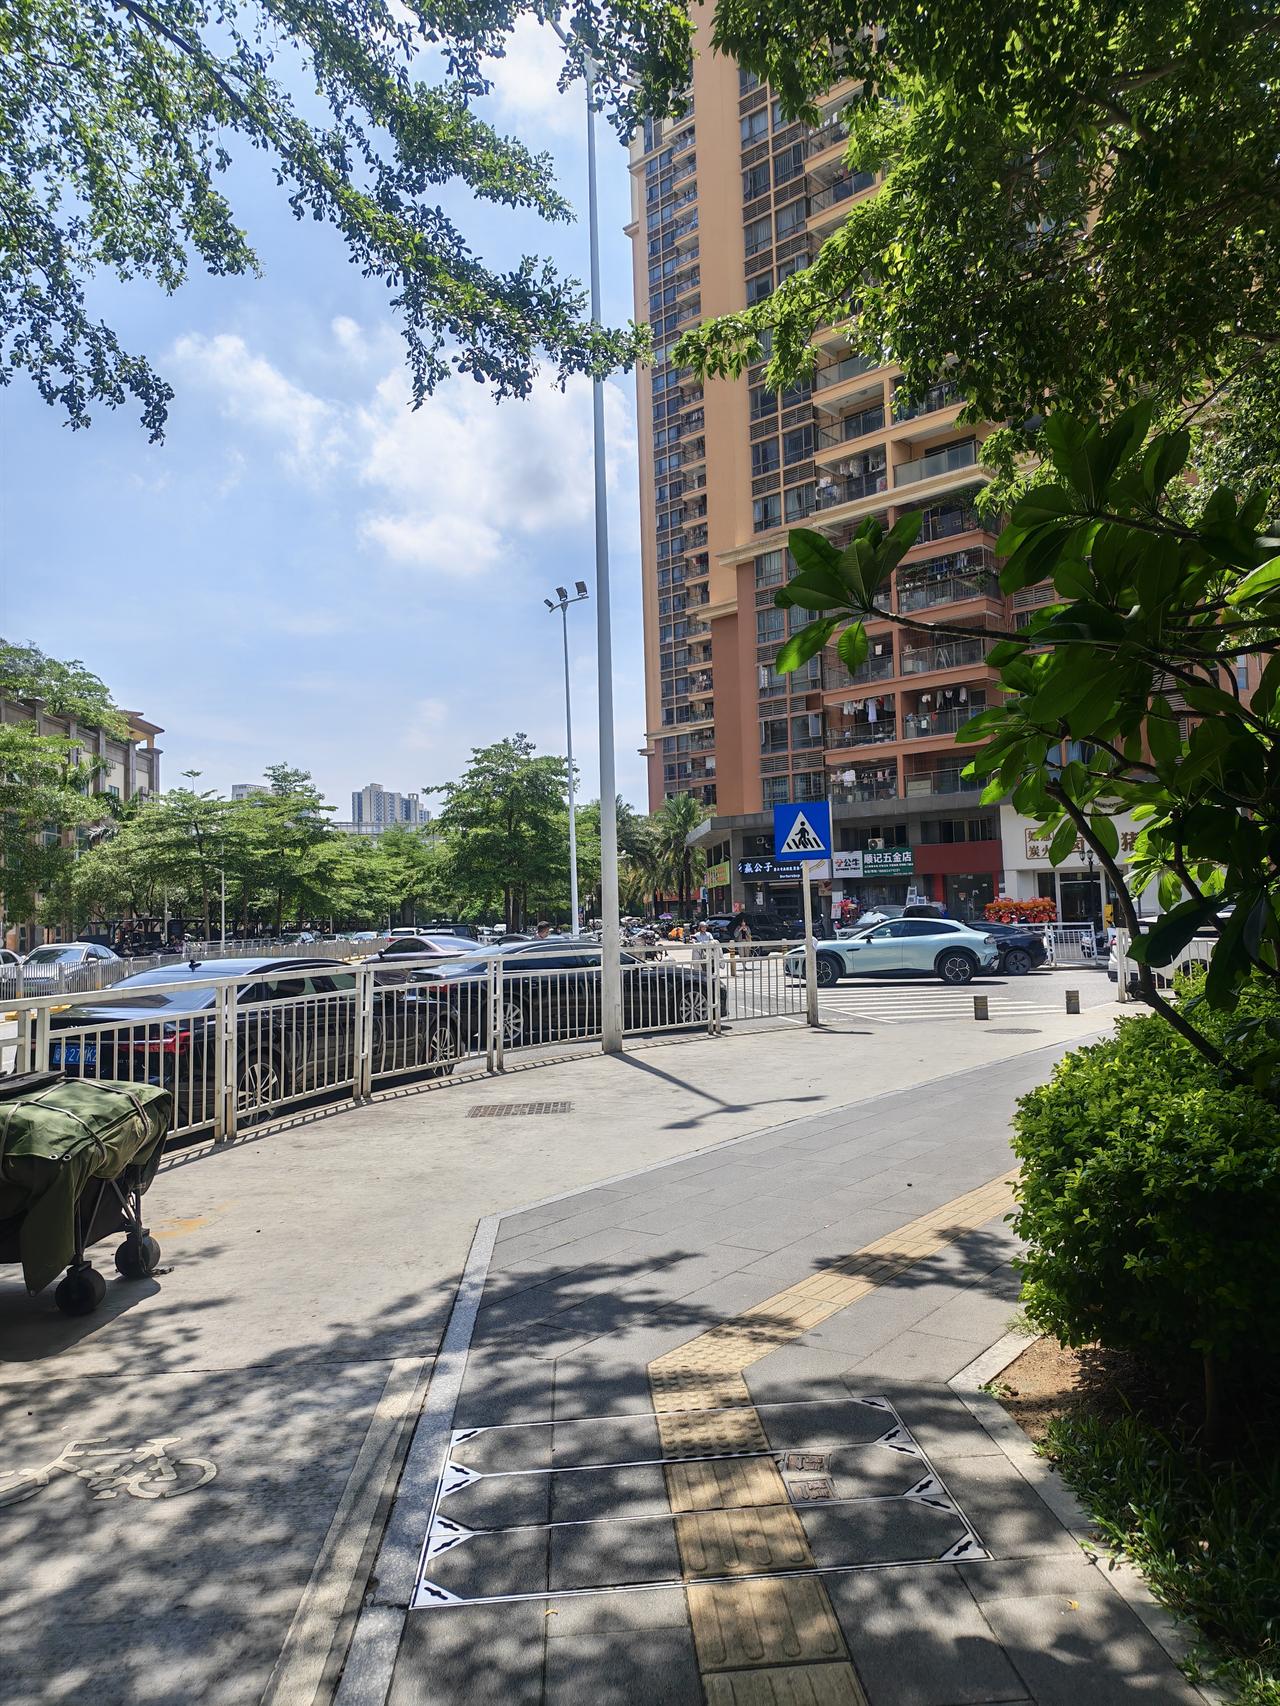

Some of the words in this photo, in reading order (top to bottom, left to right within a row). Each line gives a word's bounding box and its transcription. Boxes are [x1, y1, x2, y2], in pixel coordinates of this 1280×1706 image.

[844, 858, 860, 867] 公牛
[864, 852, 912, 864] 顺记五金店
